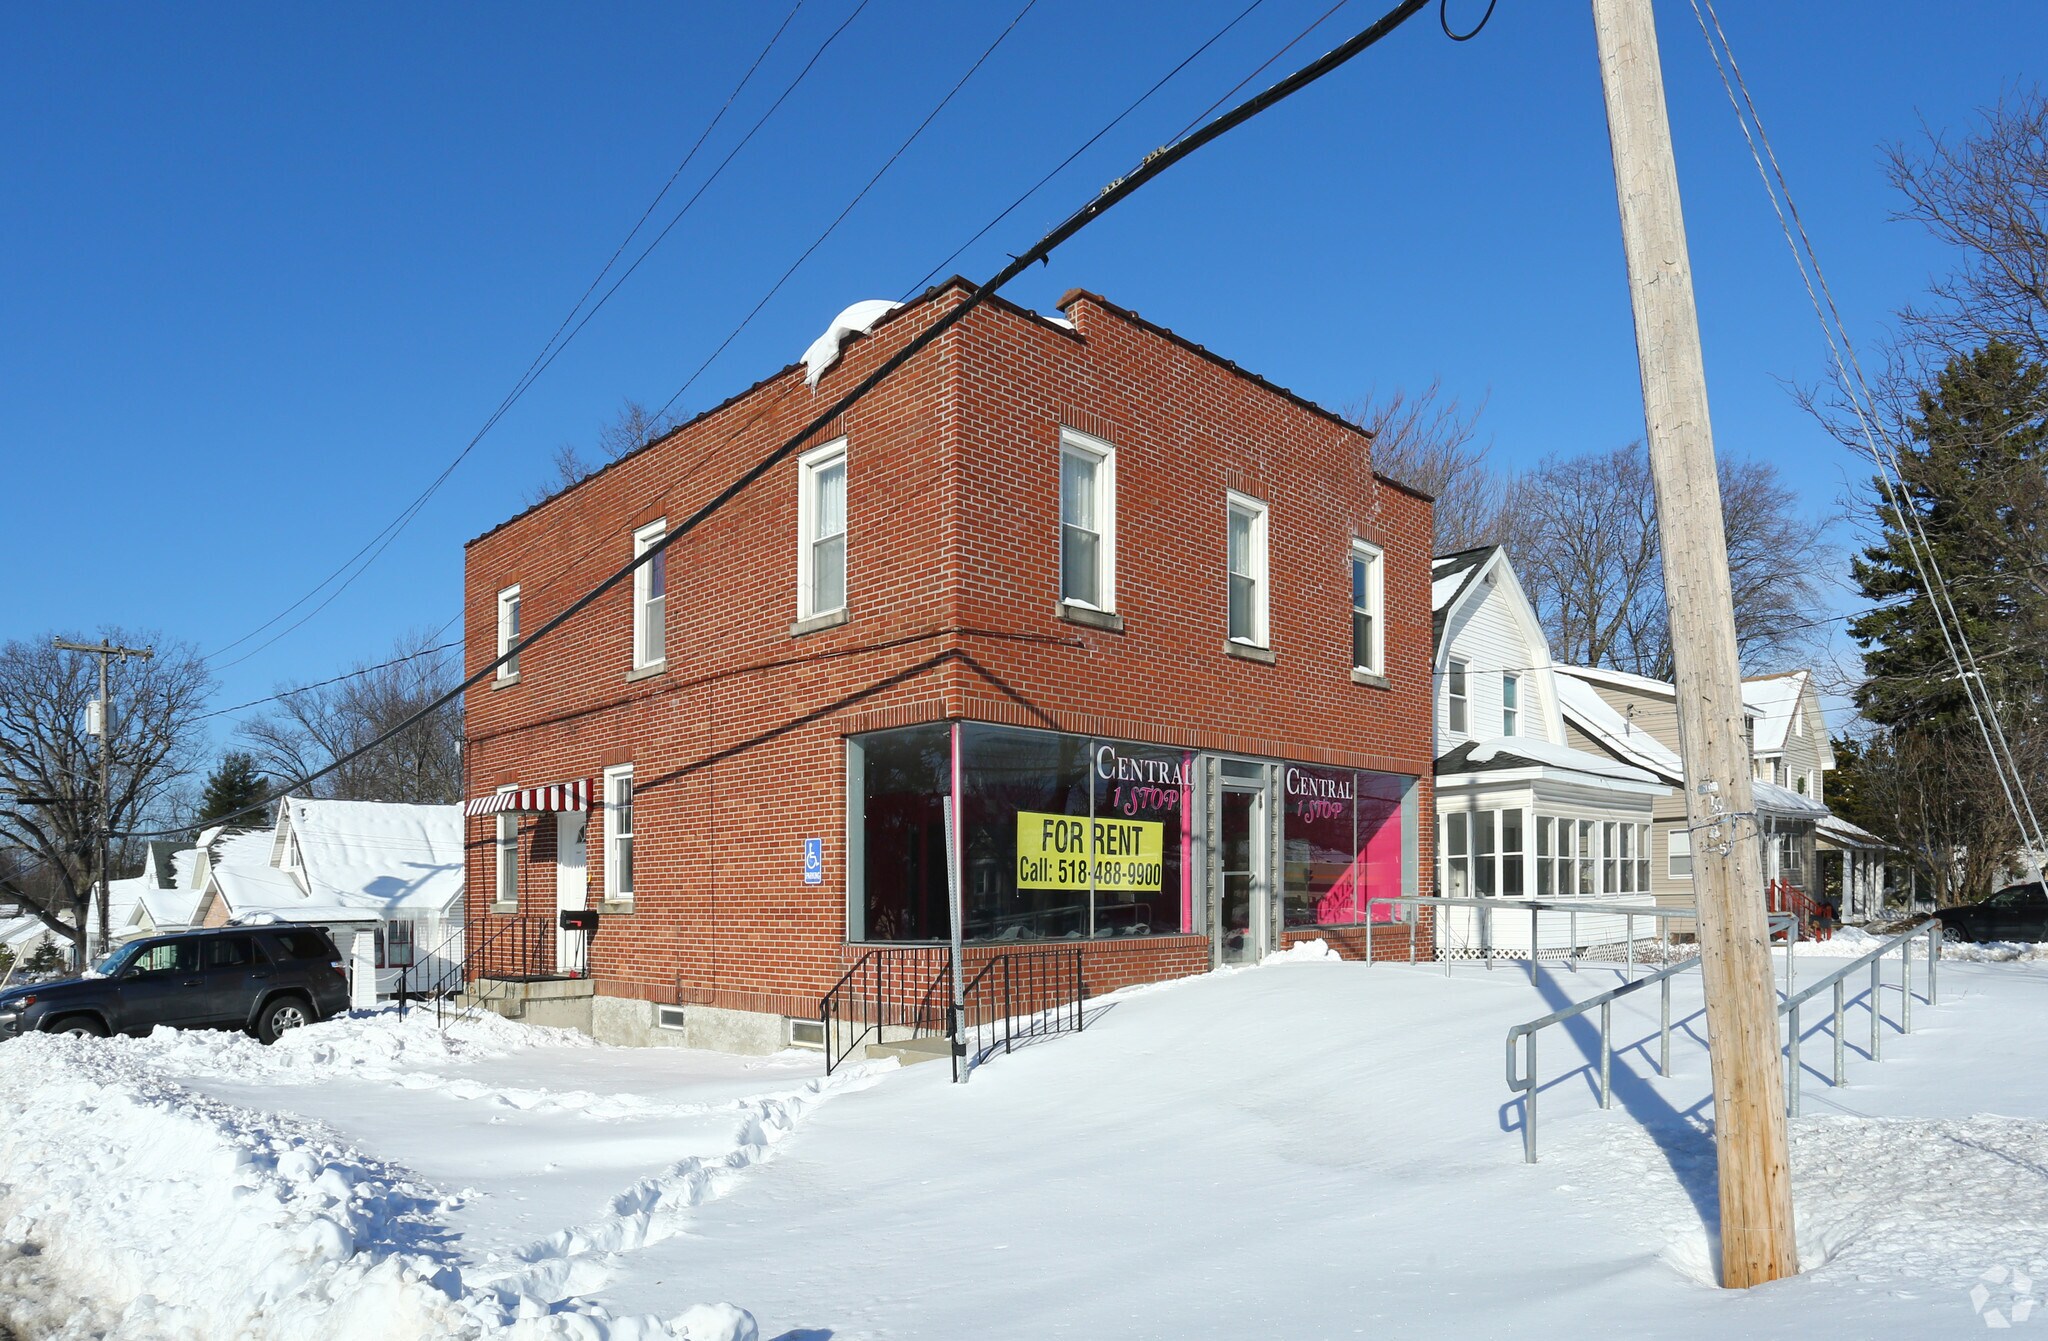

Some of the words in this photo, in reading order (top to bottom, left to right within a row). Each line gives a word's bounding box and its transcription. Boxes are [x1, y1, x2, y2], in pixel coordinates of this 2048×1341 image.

[1096, 745, 1195, 785] CENTRAL
[1286, 767, 1353, 800] CENTRAL
[1113, 786, 1121, 807] 1
[1123, 785, 1179, 816] STOP
[1304, 799, 1343, 824] STOP
[1042, 818, 1084, 854] FOR
[1092, 822, 1143, 856] RENT
[1020, 855, 1053, 882] Call:
[1058, 859, 1161, 886] 518-488-9900
